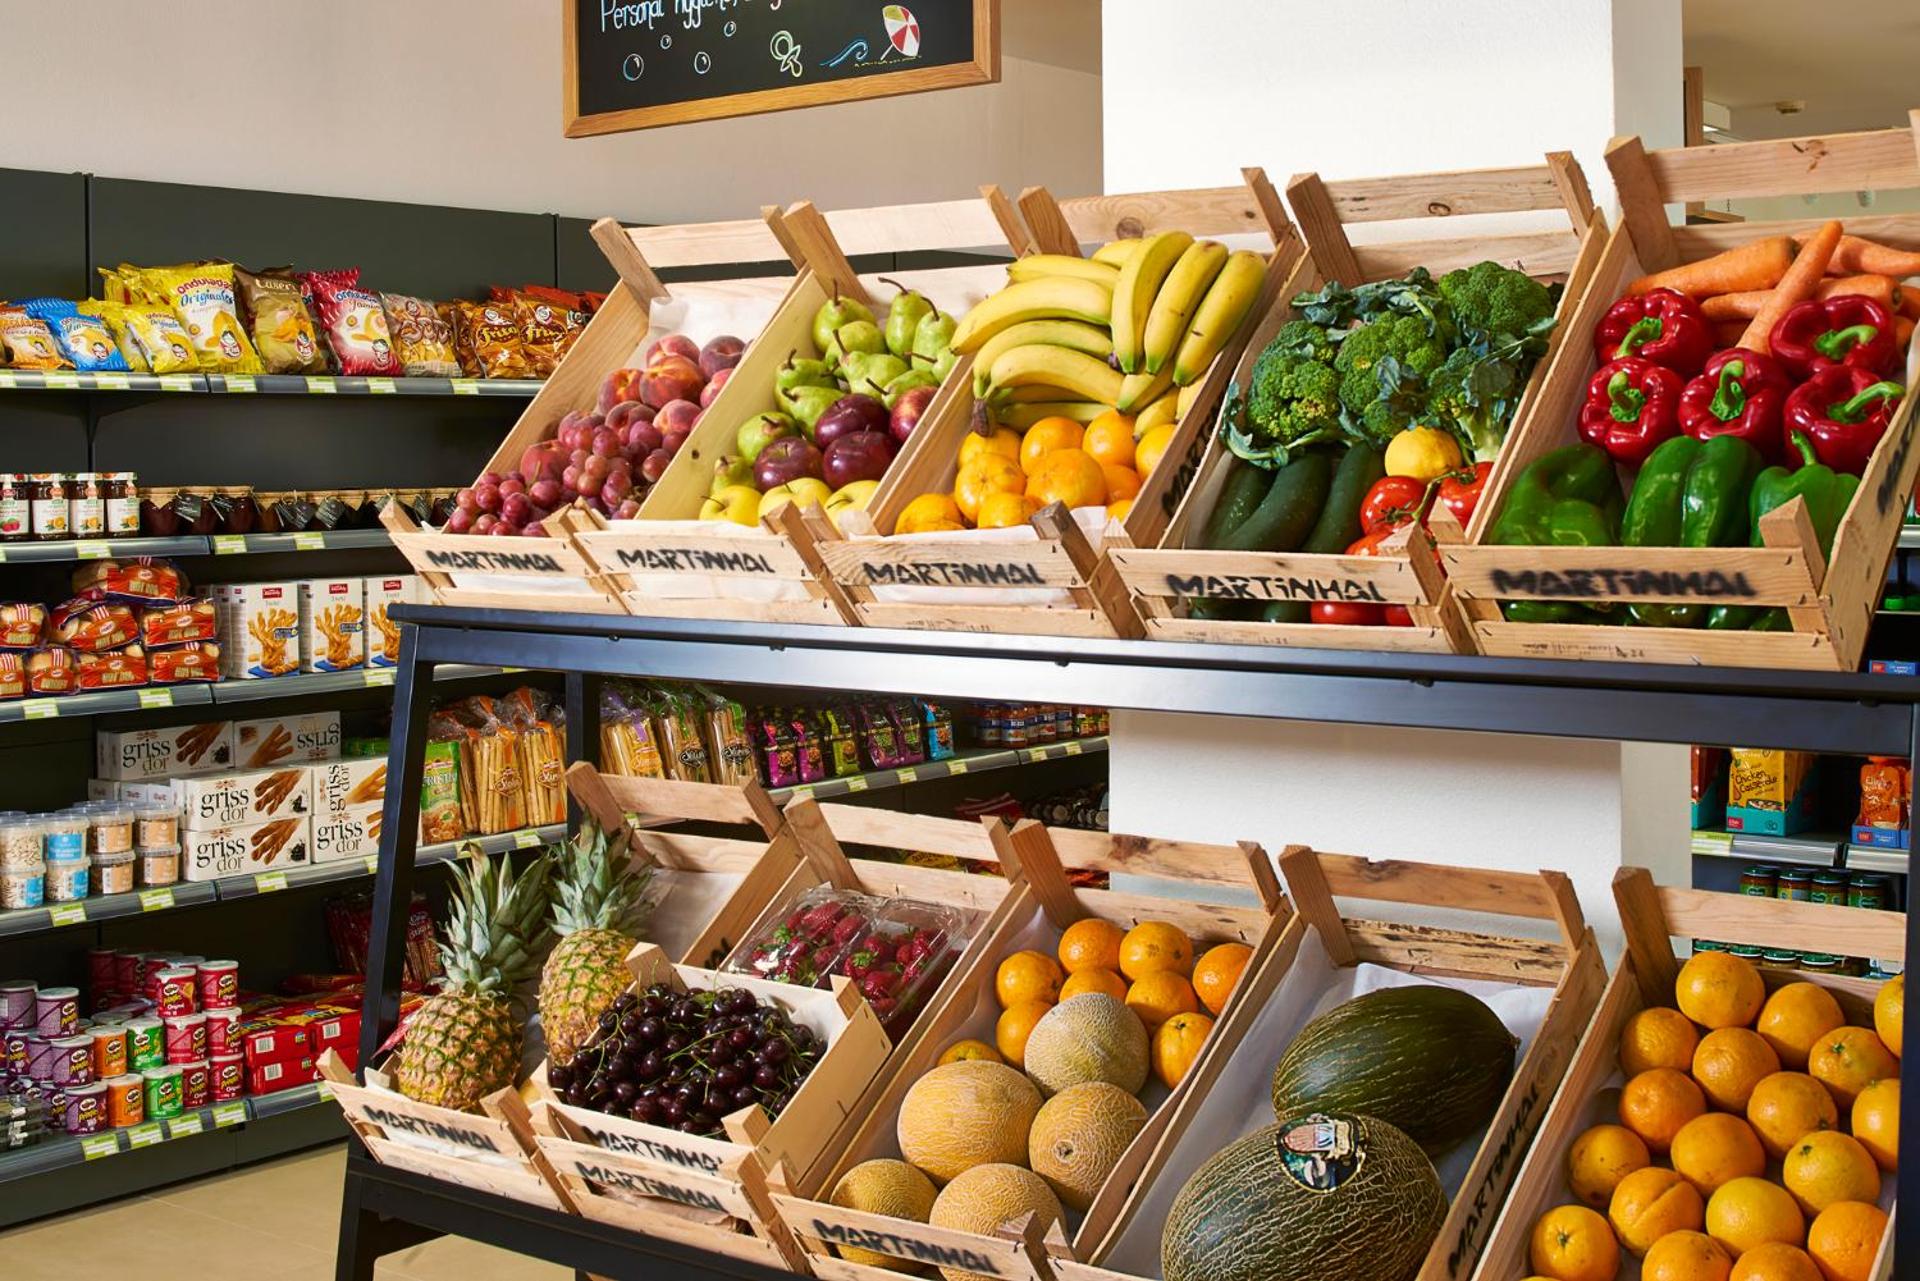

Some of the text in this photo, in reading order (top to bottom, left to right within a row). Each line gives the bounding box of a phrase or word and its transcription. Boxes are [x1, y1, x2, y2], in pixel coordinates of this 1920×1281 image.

[122, 740, 171, 769] griss
[141, 756, 170, 773] dor
[325, 764, 346, 812] griss
[200, 788, 250, 819] griss
[219, 806, 248, 824] dor
[316, 819, 364, 850] griss
[335, 838, 362, 853] dor
[196, 836, 246, 868] griss
[216, 855, 245, 873] dor
